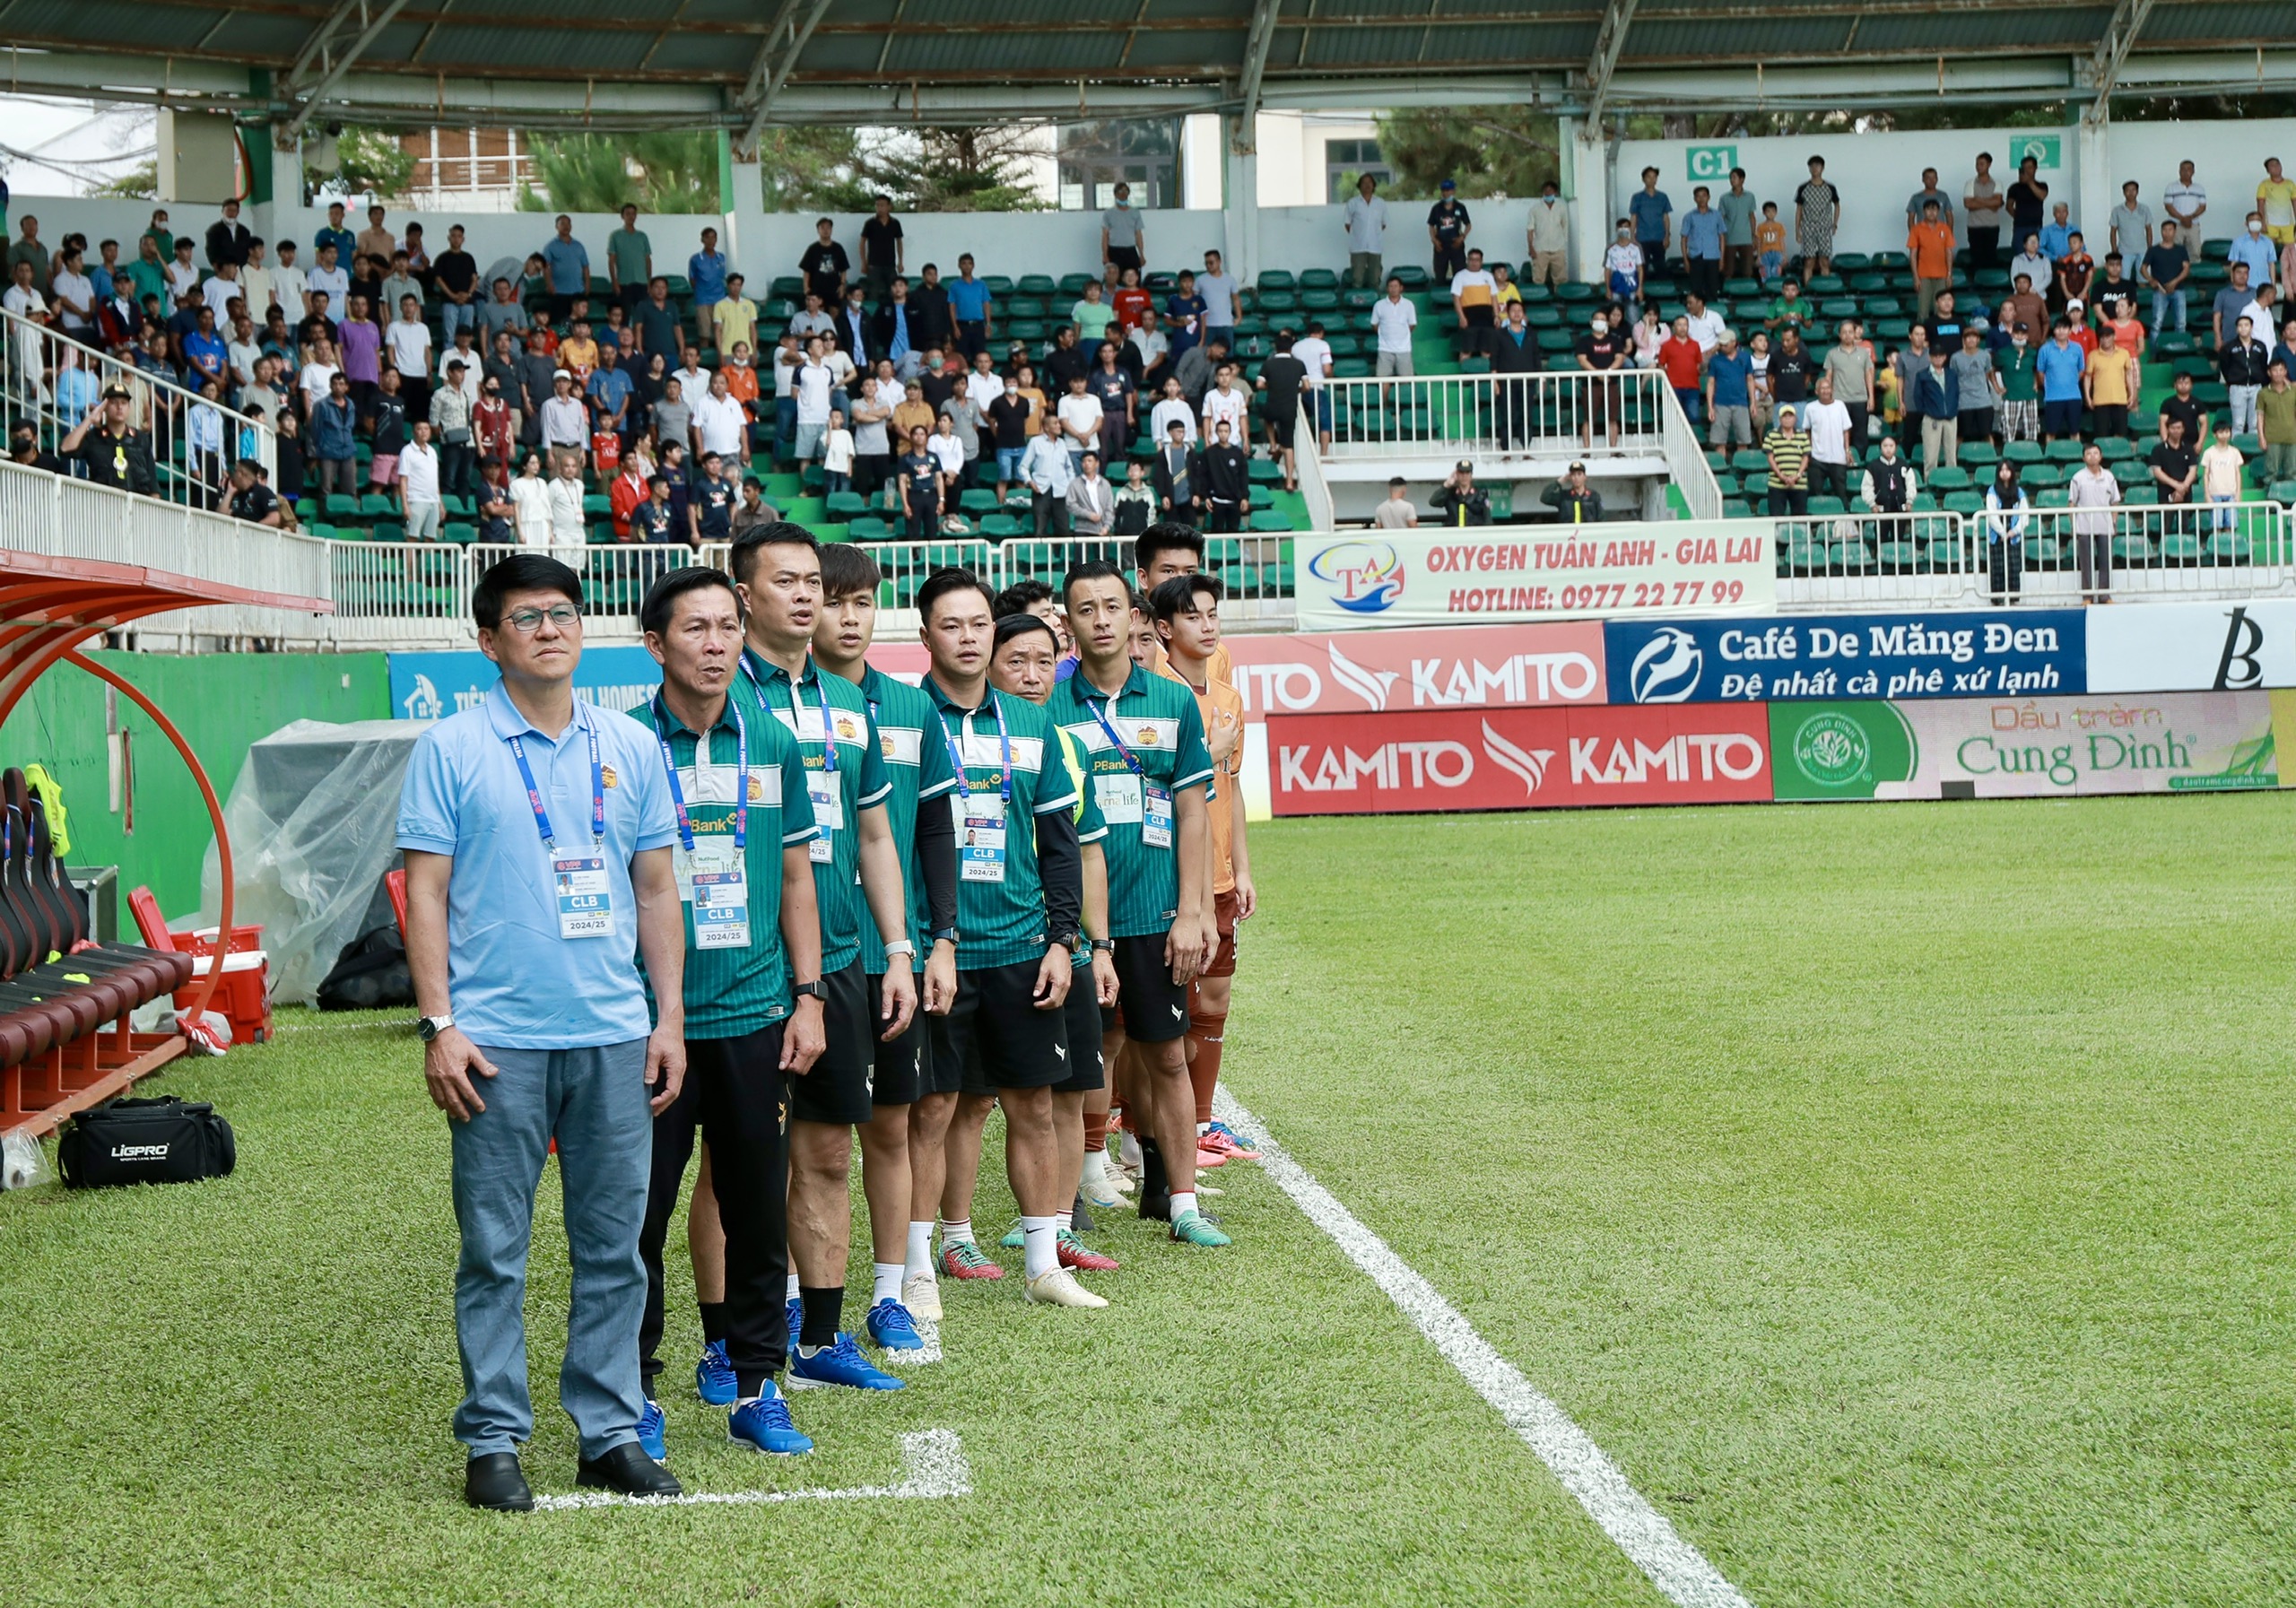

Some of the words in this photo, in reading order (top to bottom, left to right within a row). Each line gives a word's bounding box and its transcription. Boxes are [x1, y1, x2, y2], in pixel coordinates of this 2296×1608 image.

[1692, 150, 1732, 176] C1
[1427, 544, 1526, 572] OXYGEN
[1534, 529, 1597, 569] TUẤN
[1602, 540, 1656, 568] ANH
[1675, 538, 1718, 565] GIA
[1725, 537, 1763, 564] LAI
[1448, 587, 1553, 613] HOTLINE:
[1561, 584, 1627, 609] 0977
[1632, 583, 1665, 607] 22
[1672, 581, 1706, 605] 77
[1711, 580, 1744, 604] 99
[1719, 626, 1796, 661] Café
[1809, 627, 1858, 658] De
[1869, 622, 1973, 663] Măng
[1984, 622, 2059, 654] Đen
[1232, 662, 1321, 711] ITO
[1411, 652, 1597, 706] KAMITO
[1720, 674, 1763, 700] Đệ
[1772, 667, 1837, 696] nhất
[1846, 669, 1878, 694] cà
[1887, 667, 1944, 699] phê
[1952, 666, 1991, 691] xứ
[1997, 664, 2059, 696] lạnh
[597, 683, 663, 713] HOMES
[1093, 760, 1128, 771] PBank
[1279, 740, 1474, 793] KAMITO
[1570, 733, 1764, 784] KAMITO
[1957, 734, 2077, 786] Cung
[1123, 794, 1139, 805] life
[688, 818, 727, 833] Bank
[1151, 815, 1166, 826] CLB
[808, 847, 826, 856] 4/25
[973, 848, 996, 859] CLB
[969, 868, 998, 877] 2024/25
[570, 895, 598, 908] CLB
[708, 908, 735, 920] CLB
[570, 920, 606, 930] 2024/25
[706, 932, 742, 941] 2024/25
